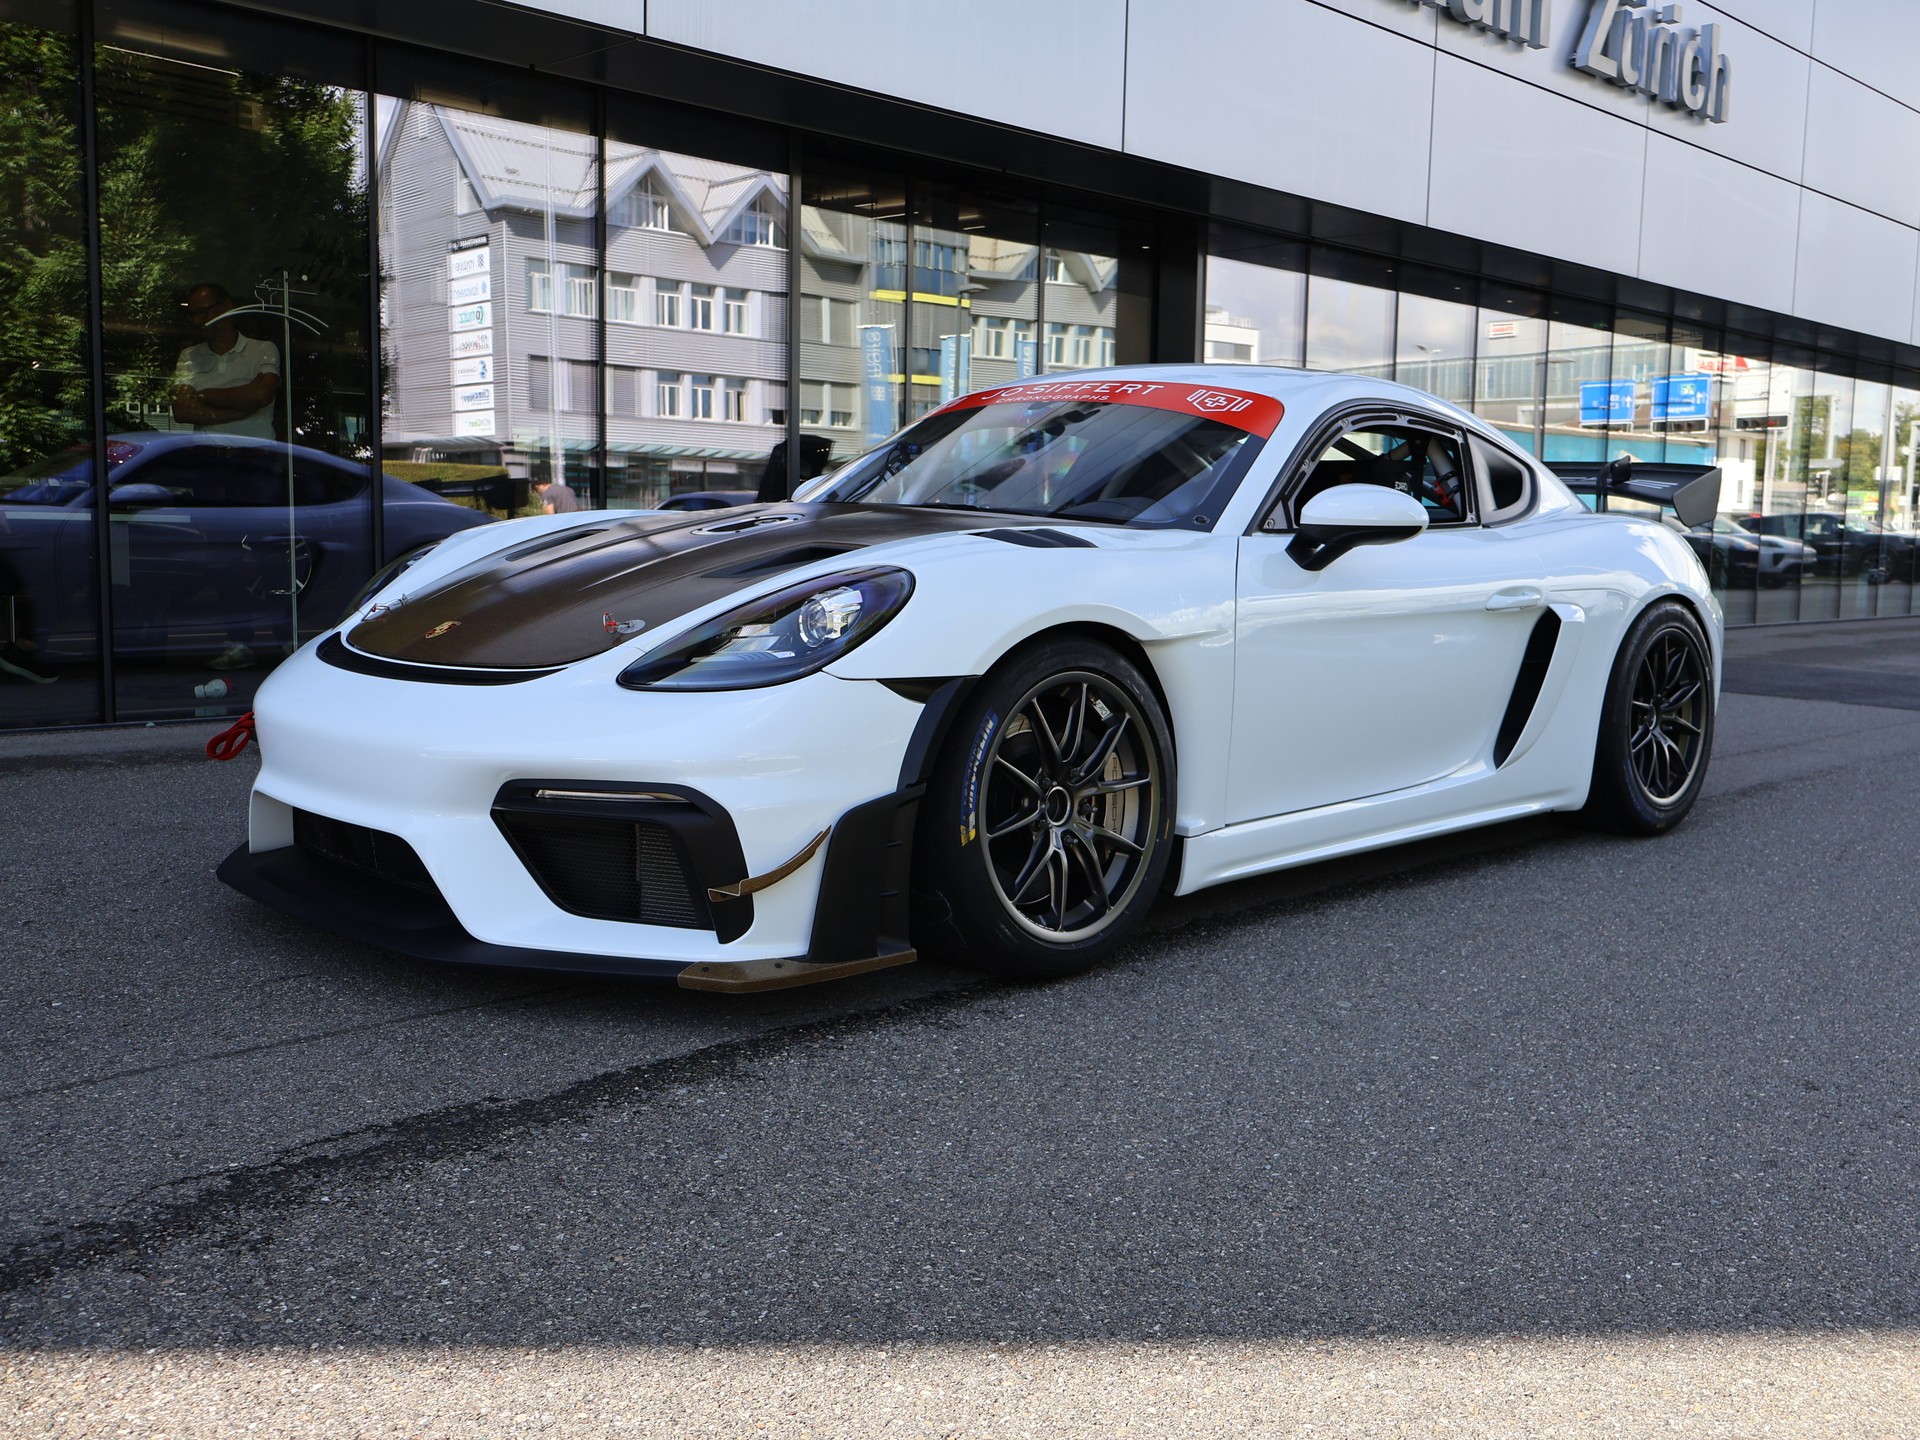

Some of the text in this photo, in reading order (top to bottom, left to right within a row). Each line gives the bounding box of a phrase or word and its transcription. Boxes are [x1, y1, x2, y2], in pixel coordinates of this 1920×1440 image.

[1574, 0, 1732, 124] Zürich
[981, 383, 1165, 400] JO SIFFERT
[996, 394, 1110, 403] CHRONOGRAPHS
